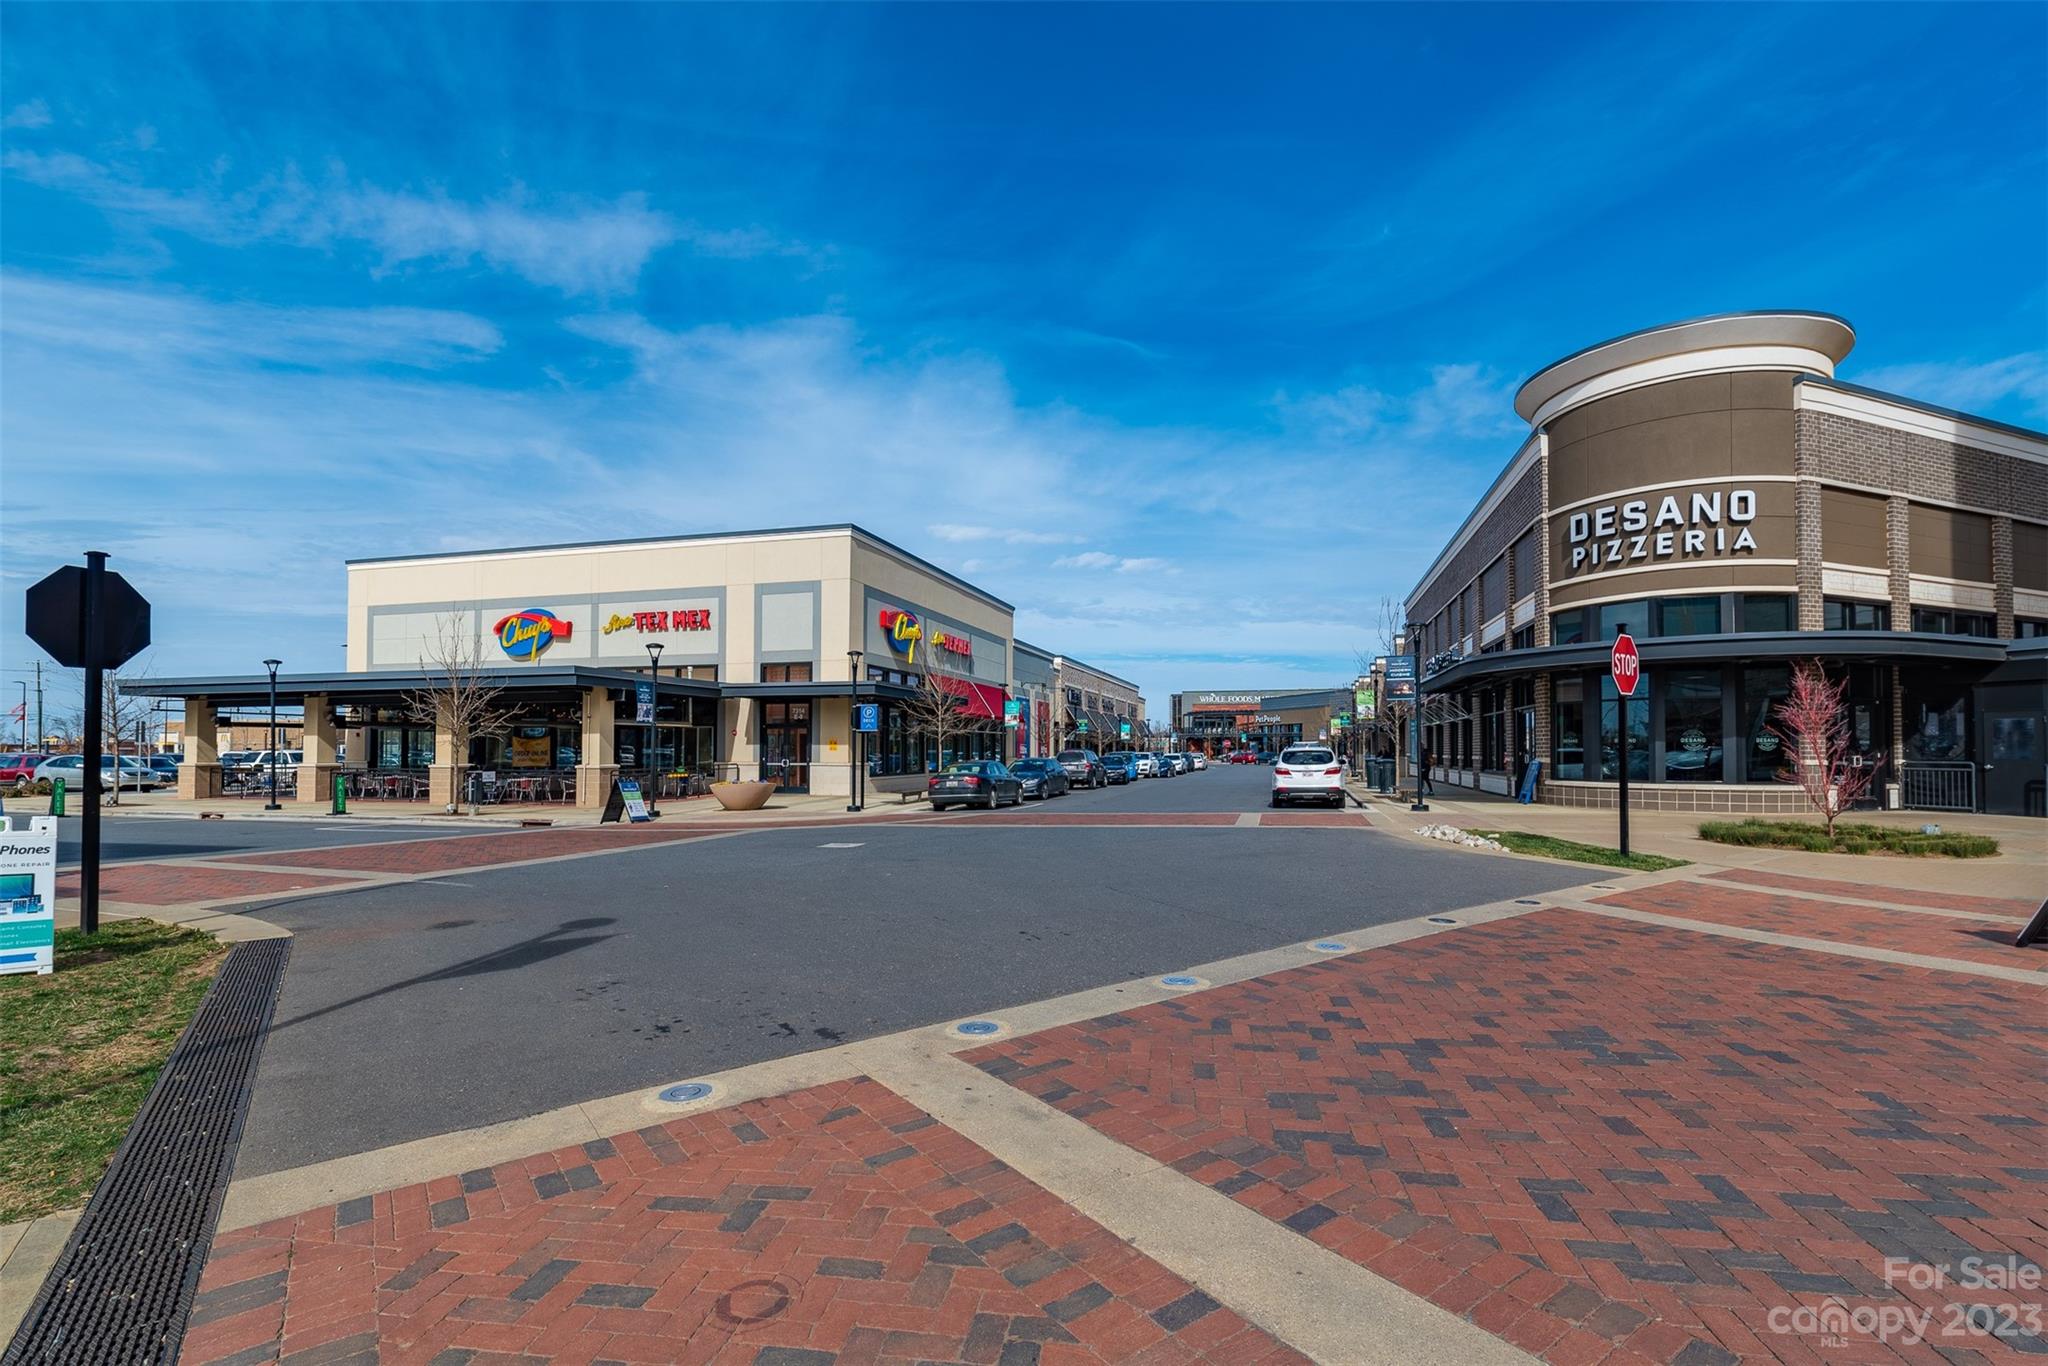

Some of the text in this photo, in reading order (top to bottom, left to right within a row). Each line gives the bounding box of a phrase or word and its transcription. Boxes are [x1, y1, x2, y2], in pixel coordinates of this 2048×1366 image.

[1570, 490, 1756, 543] DESANO
[1572, 527, 1758, 568] PIZZERIA
[633, 611, 669, 632] TEX
[672, 610, 711, 631] MEX
[502, 615, 553, 663] Chuy's
[1614, 653, 1637, 676] STOP
[1199, 692, 1226, 703] WHOLE
[1228, 695, 1253, 703] FOODS
[1255, 714, 1281, 724] PetPeople
[0, 844, 51, 855] Phones
